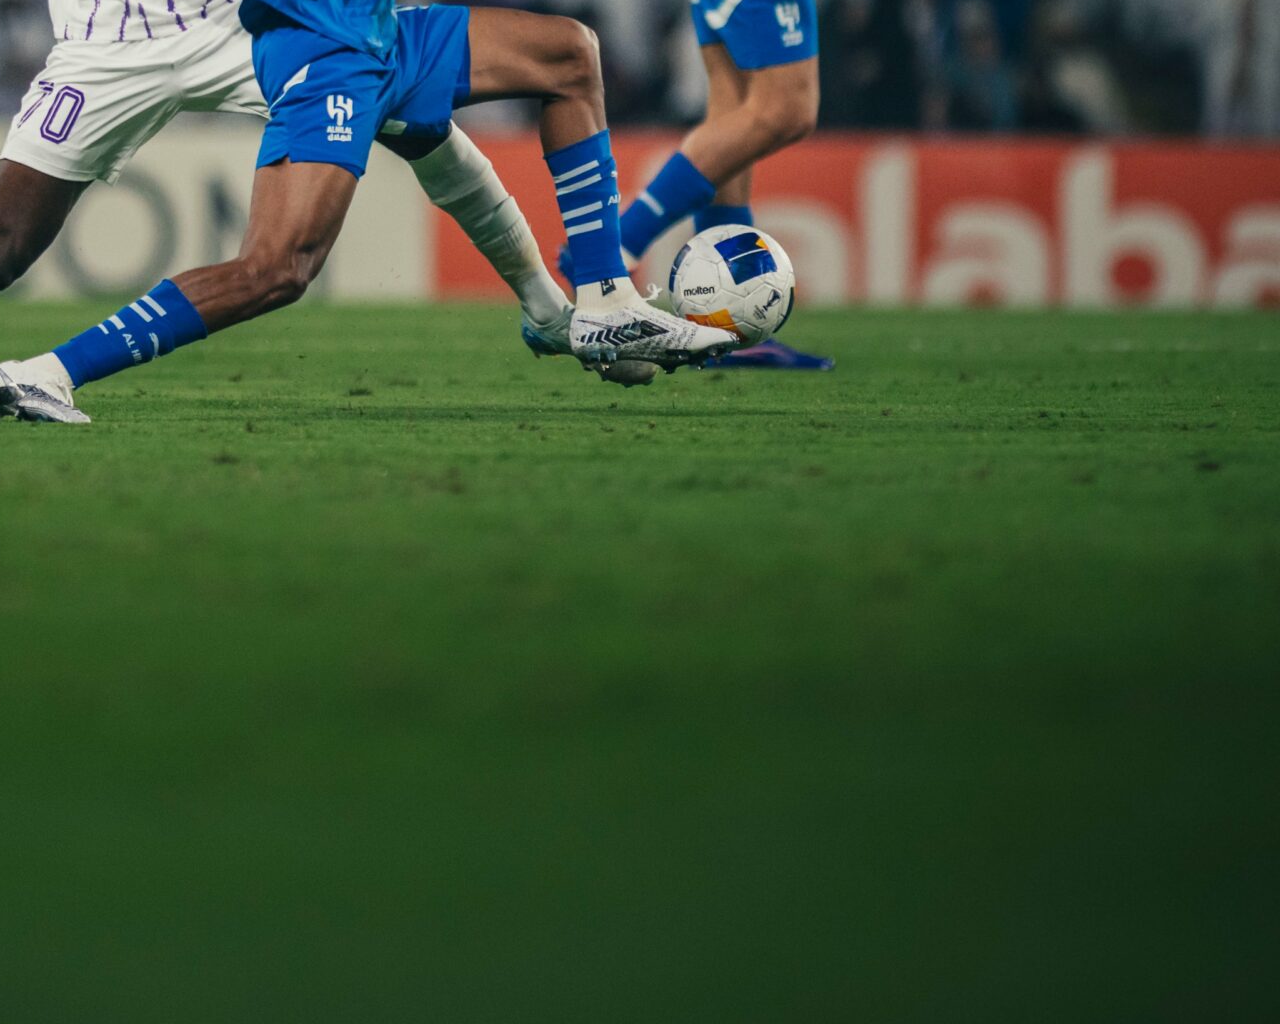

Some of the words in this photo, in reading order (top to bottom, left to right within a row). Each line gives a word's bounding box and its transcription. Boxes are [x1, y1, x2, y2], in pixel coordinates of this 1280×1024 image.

[17, 80, 85, 144] 70
[642, 141, 1280, 309] alaba
[683, 285, 716, 298] molten
